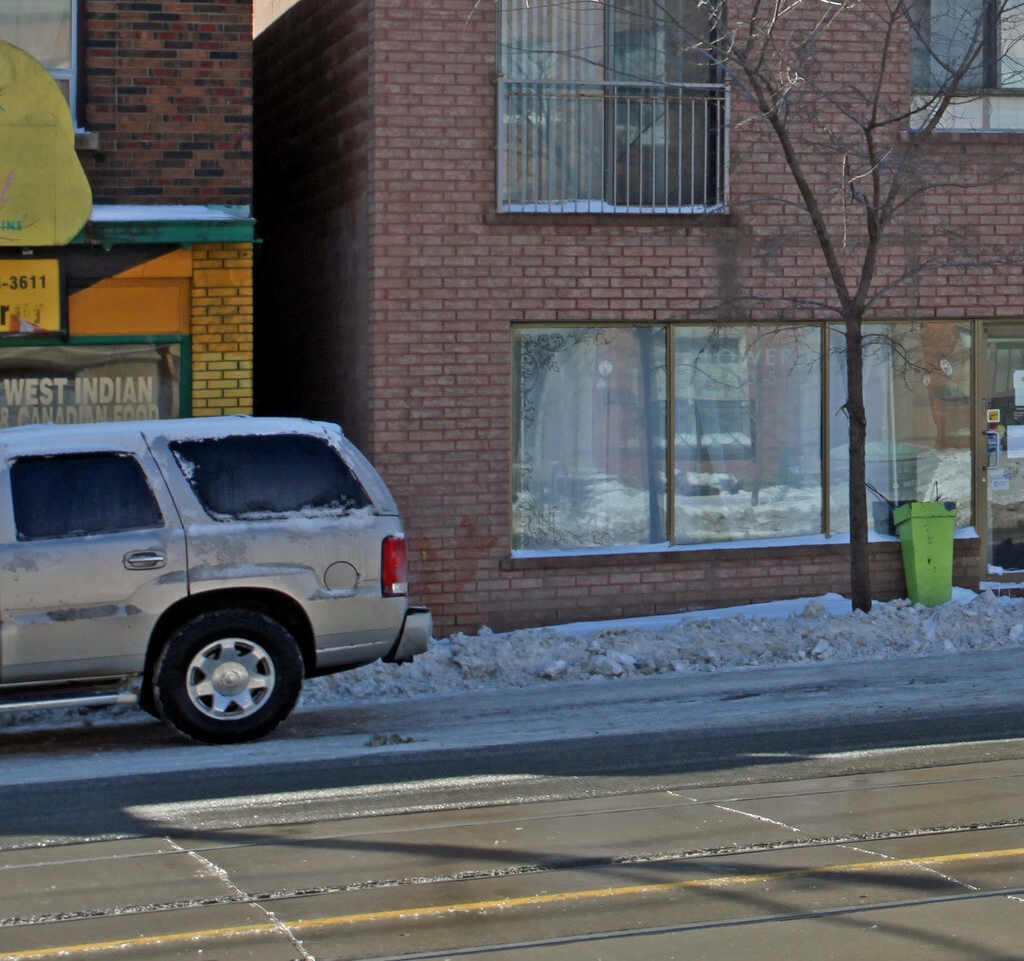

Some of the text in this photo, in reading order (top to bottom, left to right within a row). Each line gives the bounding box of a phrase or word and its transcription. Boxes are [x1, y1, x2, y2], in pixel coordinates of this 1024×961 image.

[0, 274, 46, 290] -3611
[4, 376, 153, 405] WEST INDIAN
[17, 406, 107, 425] CANADIAN
[113, 404, 160, 420] FOOD
